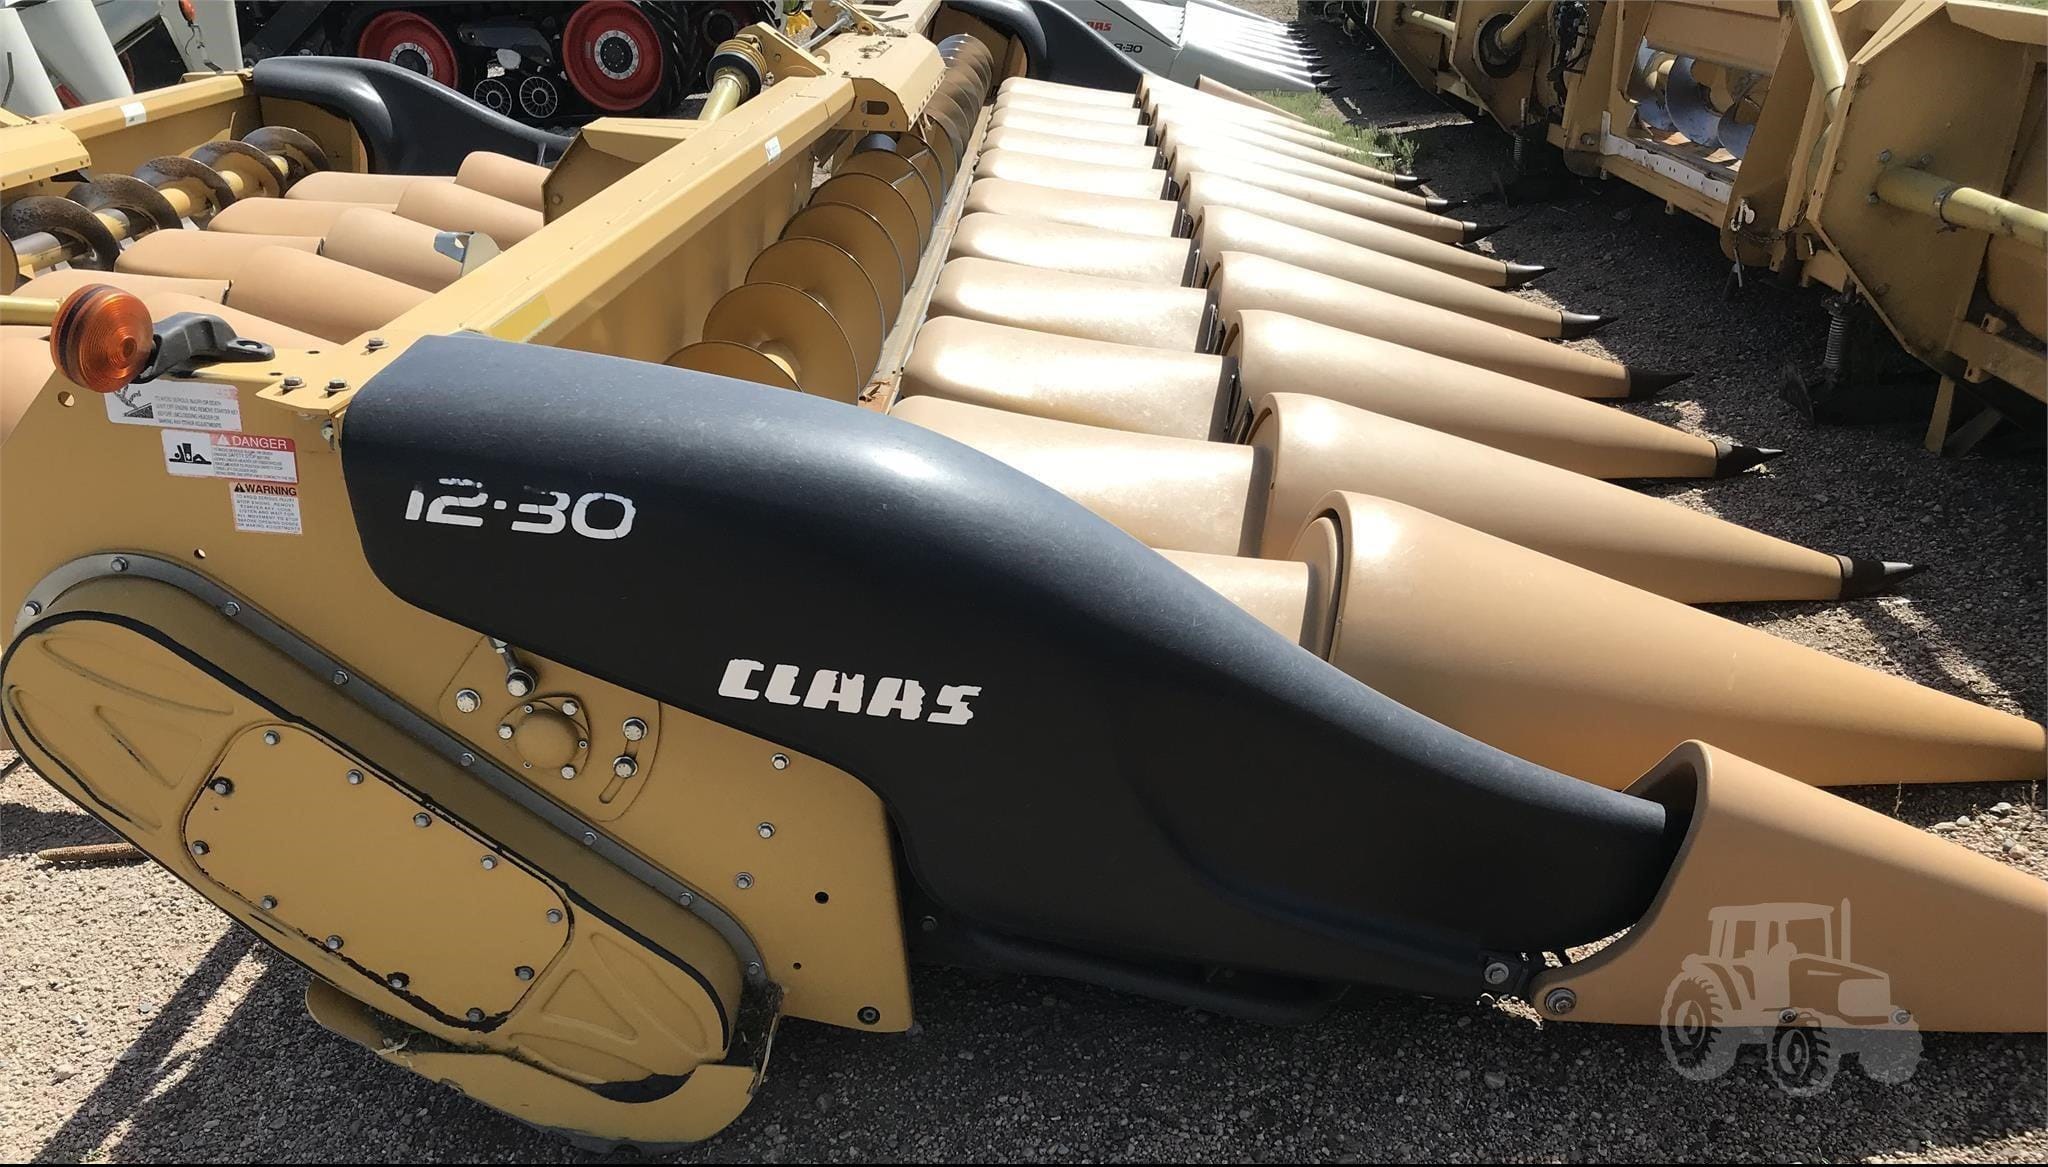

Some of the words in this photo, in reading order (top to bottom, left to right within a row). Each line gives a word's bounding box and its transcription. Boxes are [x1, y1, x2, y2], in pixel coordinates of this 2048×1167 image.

[1086, 21, 1112, 31] AAS
[231, 435, 288, 450] DANGER
[245, 484, 297, 496] WARNING
[718, 658, 982, 725] CLAAS
